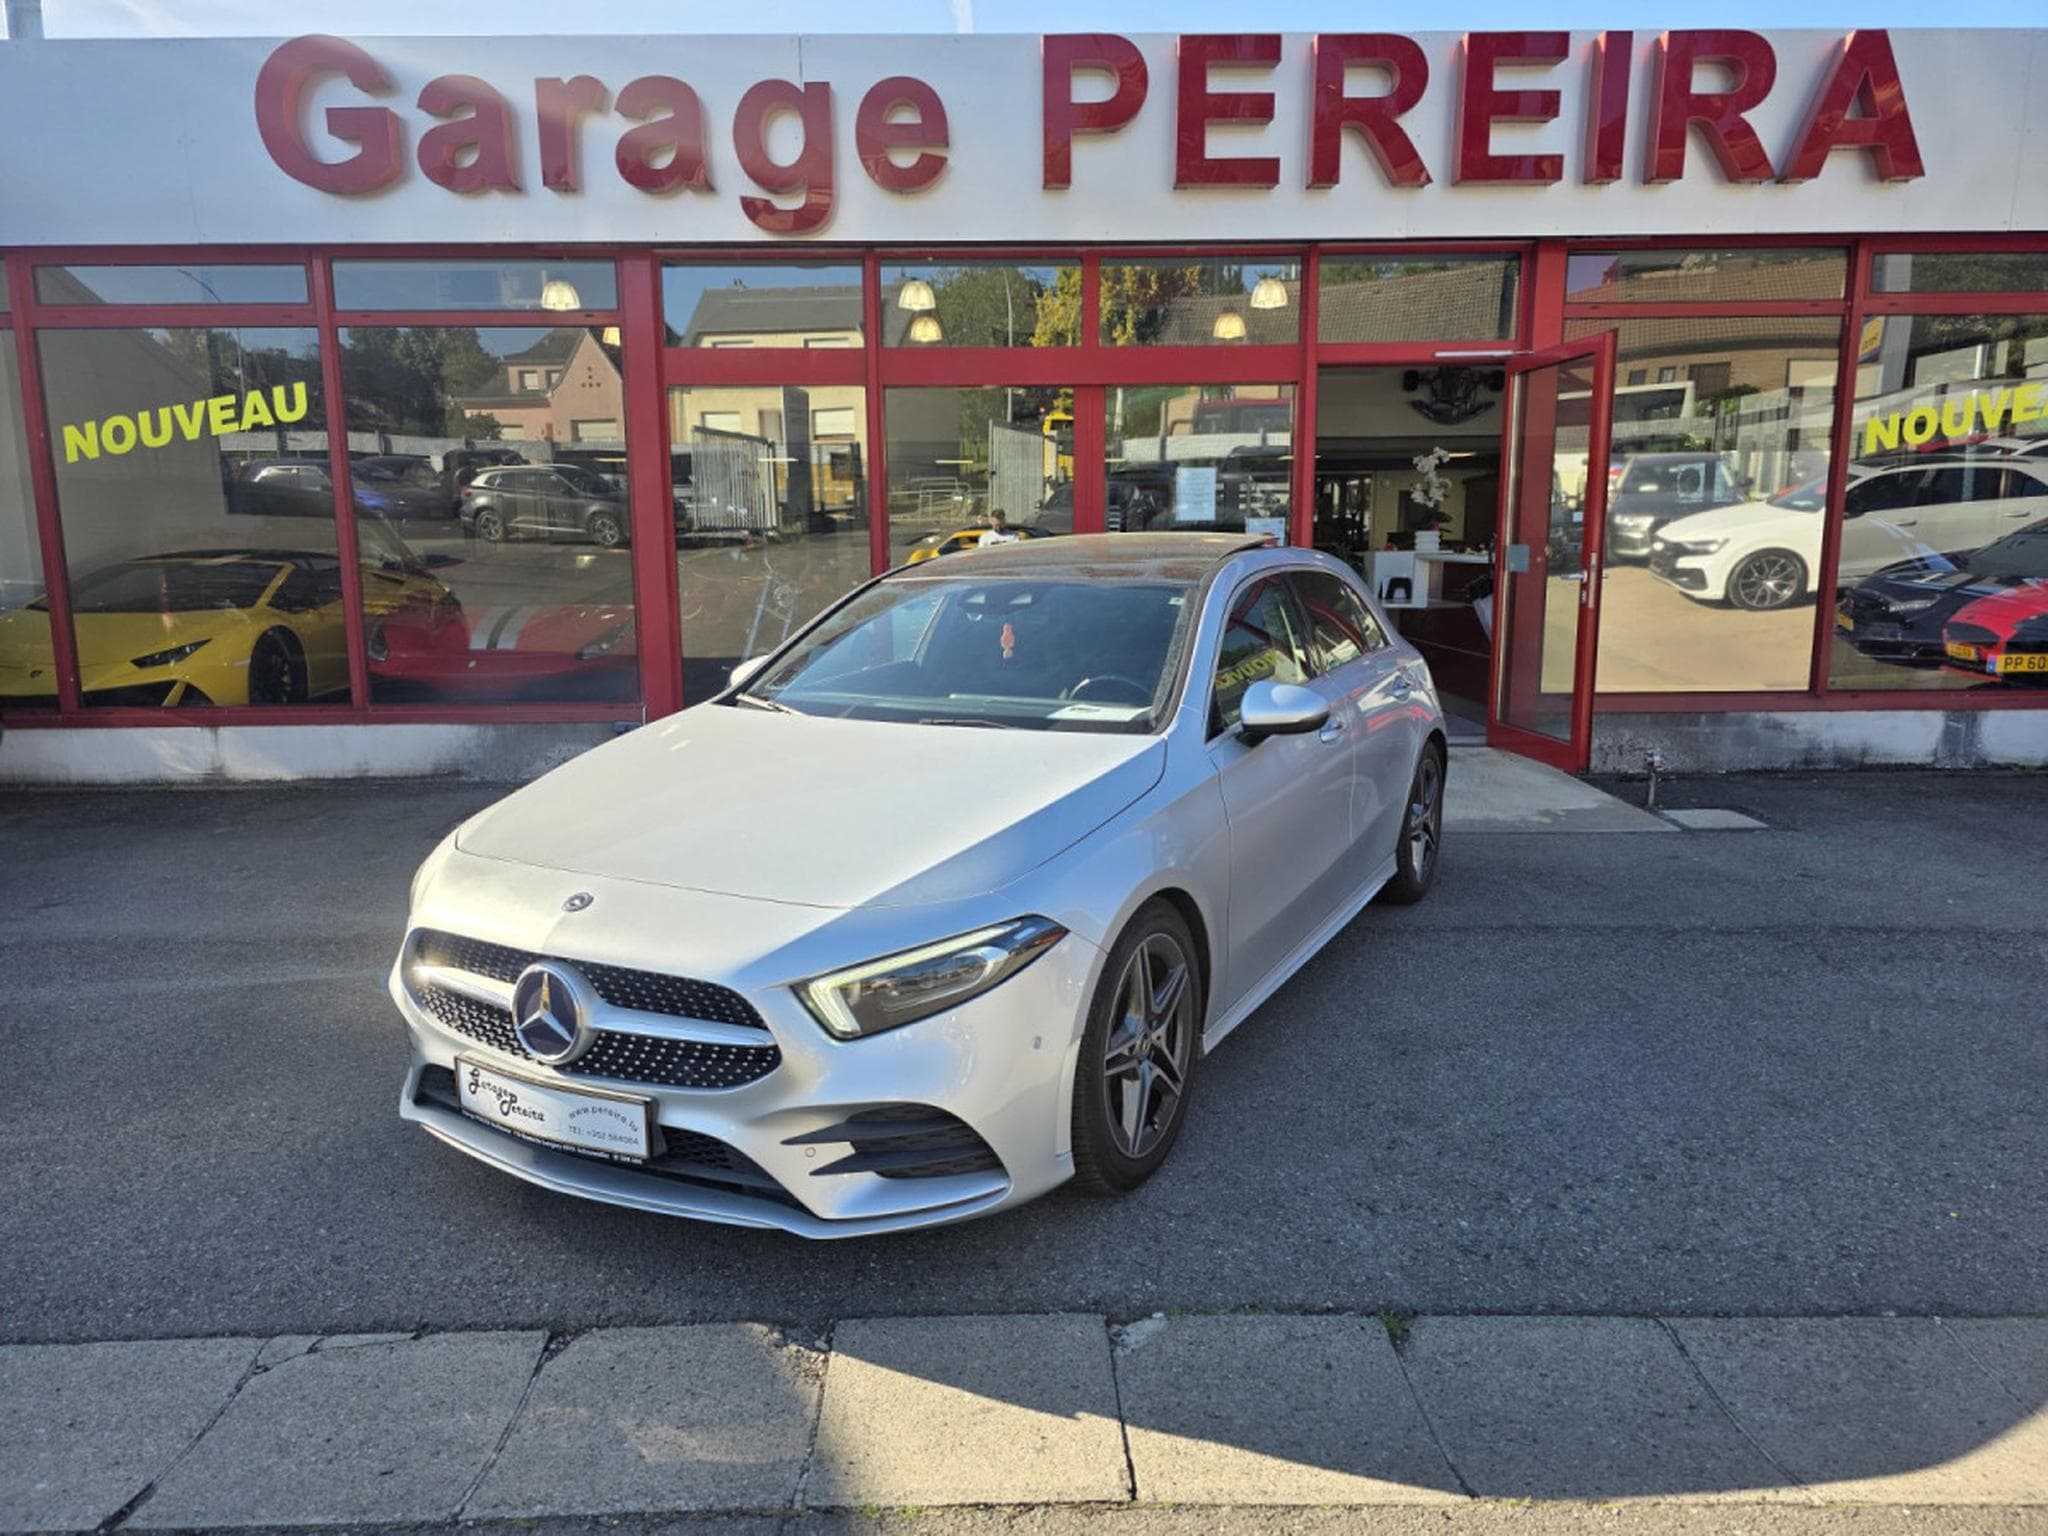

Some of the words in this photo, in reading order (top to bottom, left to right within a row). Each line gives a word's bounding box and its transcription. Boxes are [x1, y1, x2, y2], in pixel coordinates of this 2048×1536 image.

[254, 34, 950, 233] Garage
[1041, 29, 1926, 189] PEREIRA
[63, 381, 308, 463] NOUVEAU
[1865, 383, 2048, 454] NOUVE
[2003, 656, 2024, 670] PP
